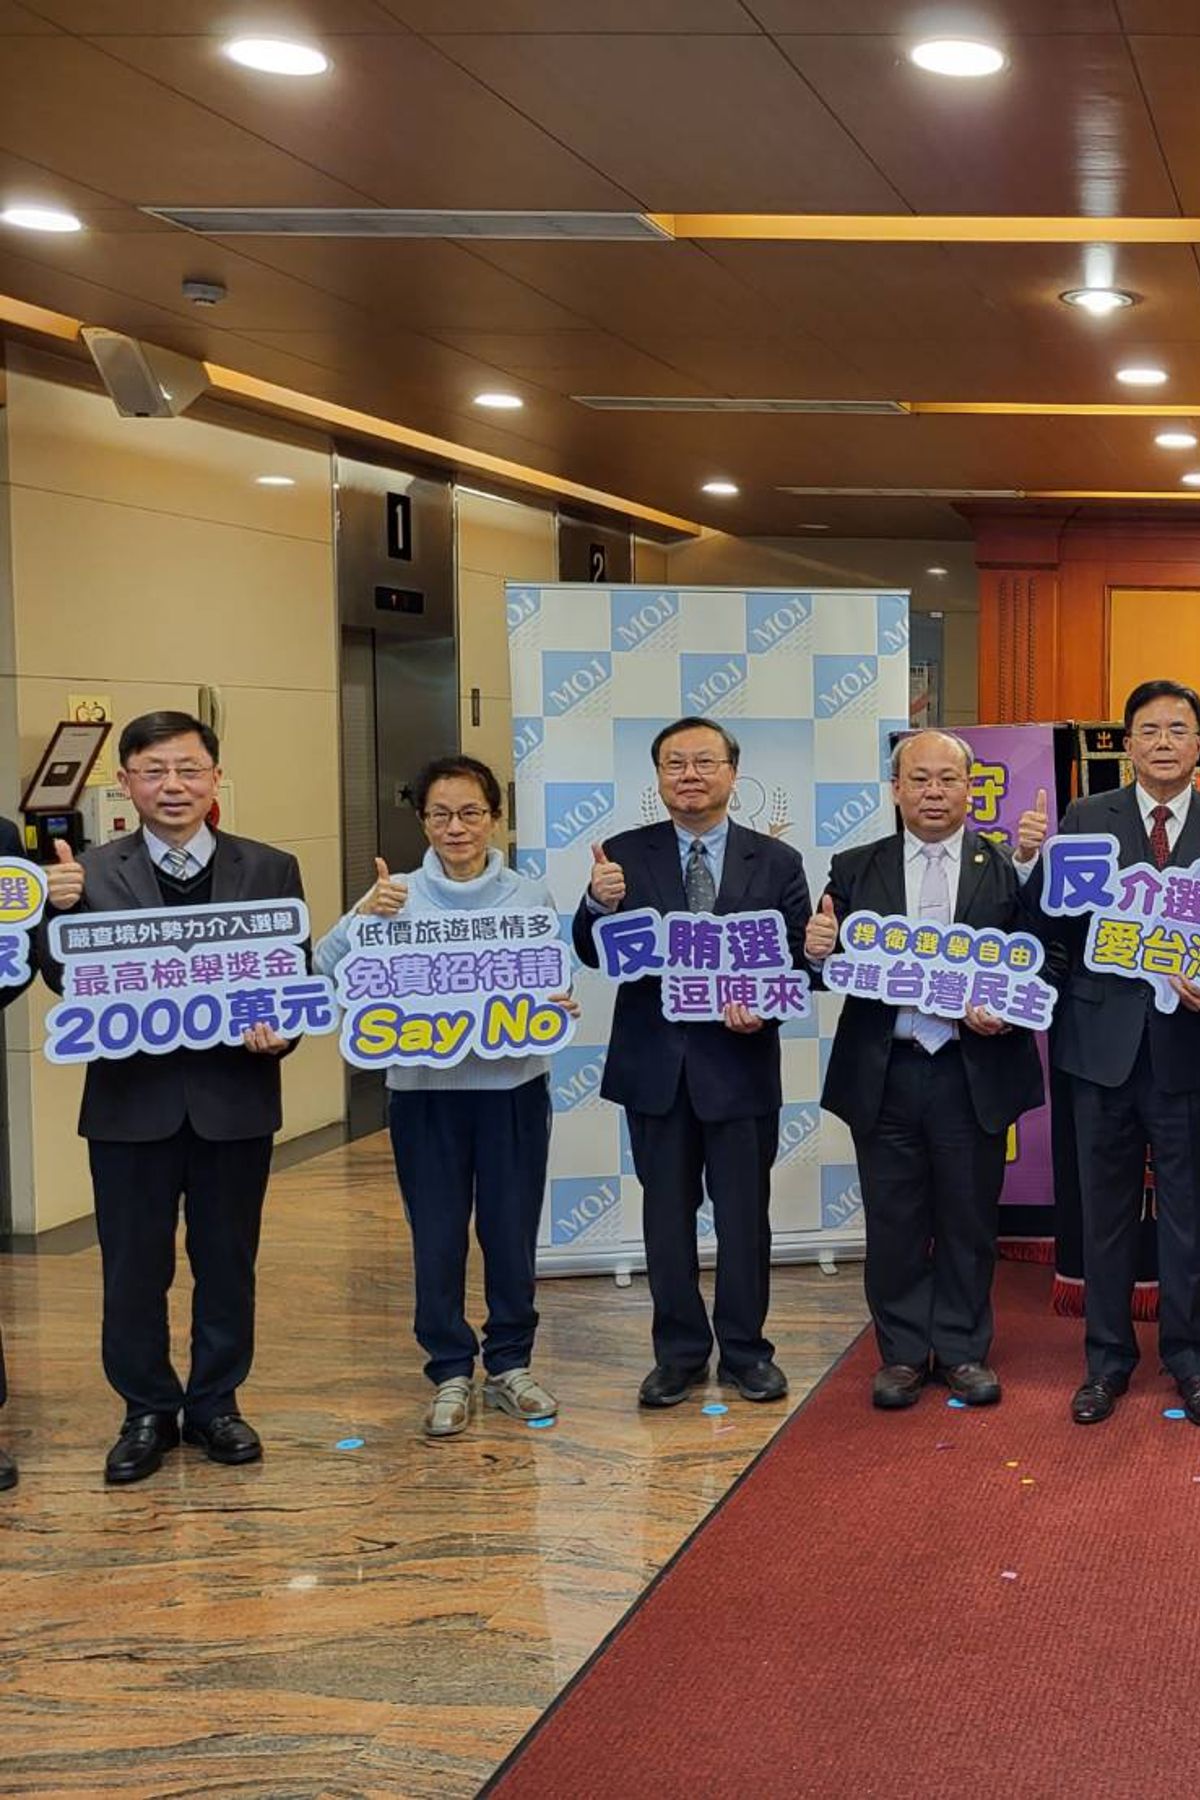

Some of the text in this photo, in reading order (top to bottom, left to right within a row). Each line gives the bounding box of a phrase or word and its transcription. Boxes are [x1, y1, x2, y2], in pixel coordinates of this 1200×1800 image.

[395, 504, 403, 549] 1
[507, 593, 537, 627] OJ
[617, 594, 674, 646] MOJ
[752, 597, 808, 648] MOJ
[549, 659, 608, 714] MOJ
[686, 659, 742, 711] MOJ
[819, 661, 877, 714] MOJ
[513, 724, 540, 758] OJ
[551, 789, 610, 842] MOJ
[821, 789, 877, 840] MOJ
[67, 911, 294, 949] 嚴查境外勢力介入選舉
[356, 914, 551, 947] 低價旅遊隱情多
[599, 915, 785, 977] 反賄選
[852, 921, 1031, 967] 捍衛選舉自由
[72, 948, 298, 997] 最高檢舉獎金
[346, 946, 562, 1000] 免費招待請
[669, 974, 806, 1015] 逗陣來
[829, 960, 1052, 1023] 守護台灣民主
[54, 983, 332, 1055] 2000萬元
[354, 996, 565, 1057] Say No
[556, 1053, 607, 1106] MO
[555, 1183, 616, 1237] MOJ
